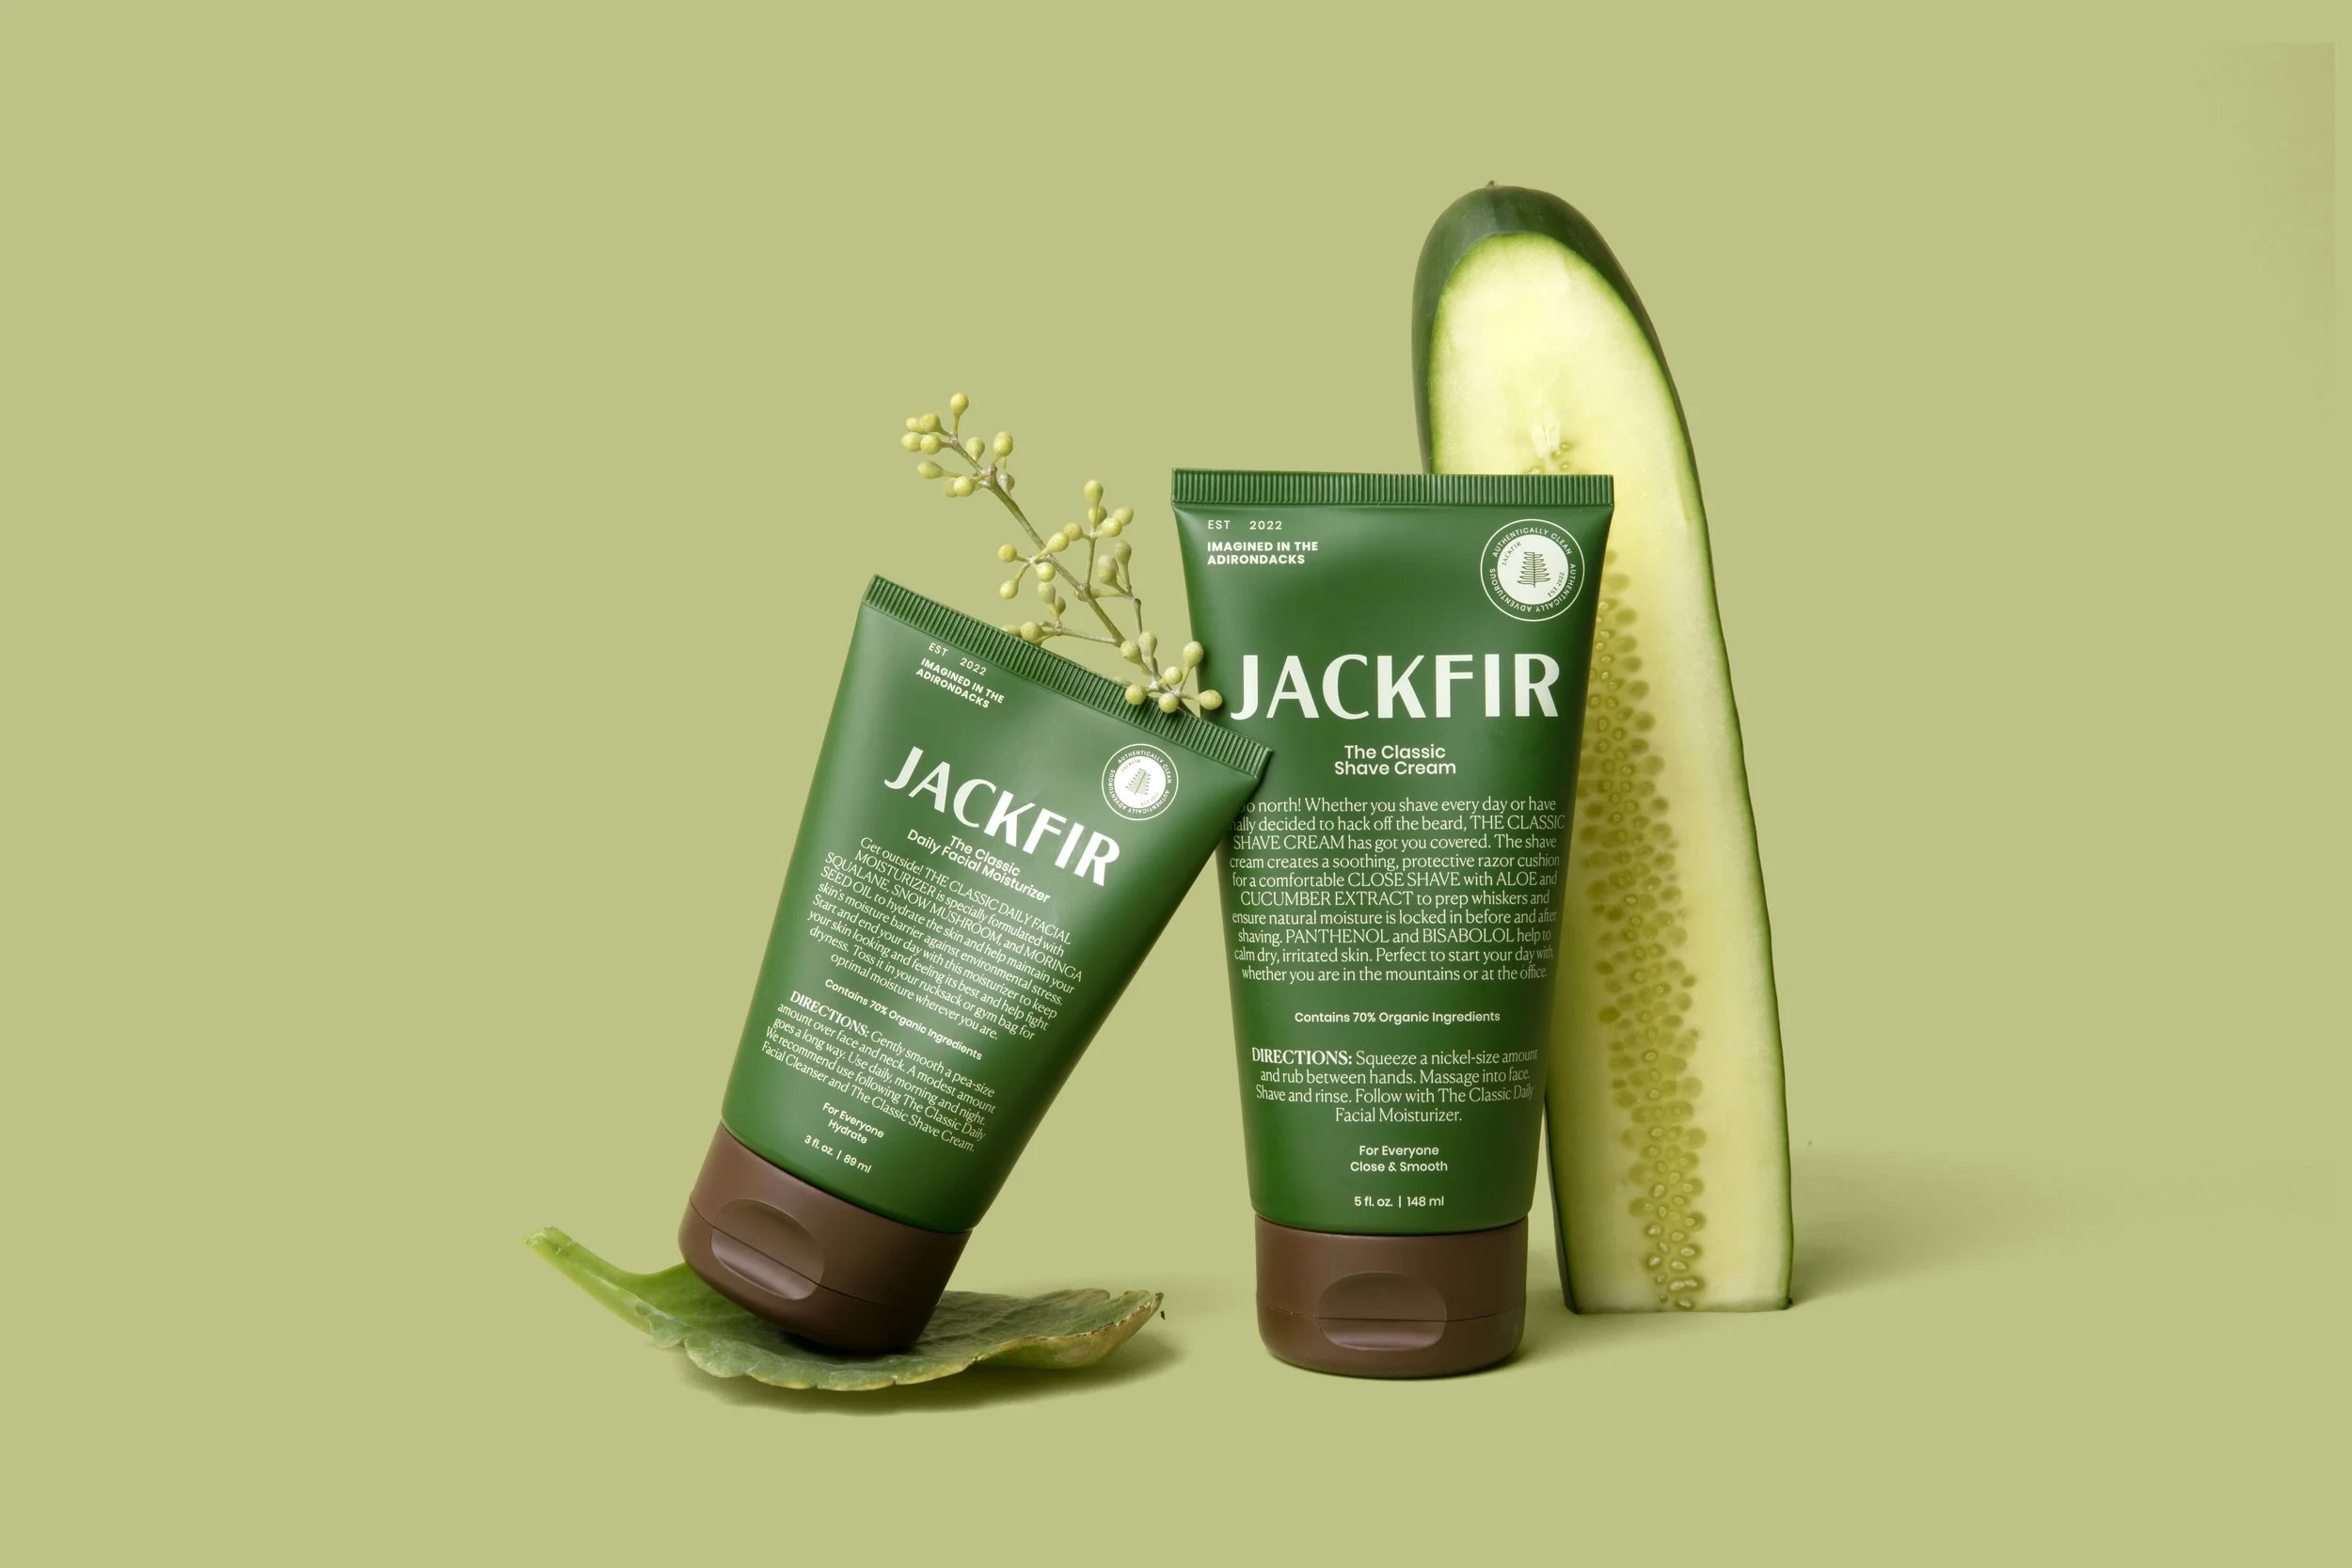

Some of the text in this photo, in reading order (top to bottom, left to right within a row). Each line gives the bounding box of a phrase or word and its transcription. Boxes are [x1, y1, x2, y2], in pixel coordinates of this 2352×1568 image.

[1208, 519, 1282, 530] EST 2022
[1207, 542, 1318, 552] IMAGINED IN THE
[1492, 527, 1573, 558] AUTHENTICALLY CLEAN
[1207, 554, 1305, 565] ADIRONDACKS
[1489, 563, 1577, 612] AUTHENTICALLY ADVENTUROUS
[929, 642, 986, 675] EST 2022
[915, 668, 990, 708] ADIRONDACKS
[921, 657, 1005, 704] IMAGINED IN THE
[1231, 654, 1560, 721] JACKFIR
[1344, 743, 1445, 759] The Classic
[1118, 750, 1165, 765] AUTHENTICALLY
[1162, 764, 1172, 784] CLEAN
[1335, 760, 1456, 775] Shave Cream
[1107, 768, 1126, 810] ADVENTUROUS
[1128, 789, 1170, 815] AUTHENTICALLY
[883, 746, 1120, 886] JACKFIR
[1258, 797, 1301, 813] north!
[1305, 797, 1368, 812] Whether
[1370, 801, 1396, 816] you
[1399, 797, 1438, 812] shave
[1441, 800, 1480, 815] every
[1482, 796, 1508, 815] day
[1510, 800, 1526, 811] or
[1529, 796, 1556, 811] have
[1258, 816, 1316, 832] decided
[1319, 820, 1334, 831] to
[1338, 816, 1371, 831] hack
[1374, 816, 1393, 831] off
[1396, 816, 1419, 831] the
[1422, 815, 1467, 832] beard,
[1470, 815, 1504, 830] THE
[1507, 815, 1565, 830] CLASSIC
[950, 835, 1021, 877] The Classic
[1233, 833, 1557, 853] SHAVE CREAM has got you covered. The shave
[907, 829, 1051, 903] Daily Facial Moisturizer
[1230, 852, 1560, 872] cream creates a soothing, protective razor cushion
[854, 849, 1064, 957] MOISTURIZER is specially formulated with
[861, 837, 1071, 944] Get outside! THE CLASSIC DAILY FACIAL
[1241, 889, 1549, 909] CUCUMBER EXTRACT to prep whiskers and
[825, 852, 1082, 982] SQUALANE, SNOW MUSHROOM, and MORINGA
[1238, 927, 1551, 947] shaving. PANTHENOL and BISABOLOL help to
[831, 954, 997, 1040] optimal moisture wherever you are.
[825, 979, 982, 1060] Contains 70% Organic Ingredients
[1295, 1011, 1501, 1025] Contains 70% Organic Ingredients
[790, 990, 994, 1098] DIRECTIONS: Gently smooth a pea-size
[1251, 1047, 1538, 1069] DIRECTIONS: Squeeze a nickel-size amount
[762, 1040, 974, 1151] Facial Cleanser and The Classic Shave Cream.
[822, 1102, 884, 1138] For Everyone
[1336, 1107, 1462, 1122] Facial Moisturizer.
[828, 1119, 867, 1144] Hydrate
[804, 1135, 812, 1144] 3
[821, 1145, 833, 1156] oz.
[844, 1154, 857, 1166] 89
[857, 1163, 872, 1173] ml
[1350, 1161, 1448, 1172] Close & Smooth
[1359, 1146, 1439, 1159] For Everyone
[1354, 1196, 1361, 1207] 5
[1364, 1196, 1375, 1207] fl.
[1376, 1198, 1393, 1207] oz.
[1406, 1196, 1426, 1207] 148
[1429, 1196, 1444, 1206] ml
